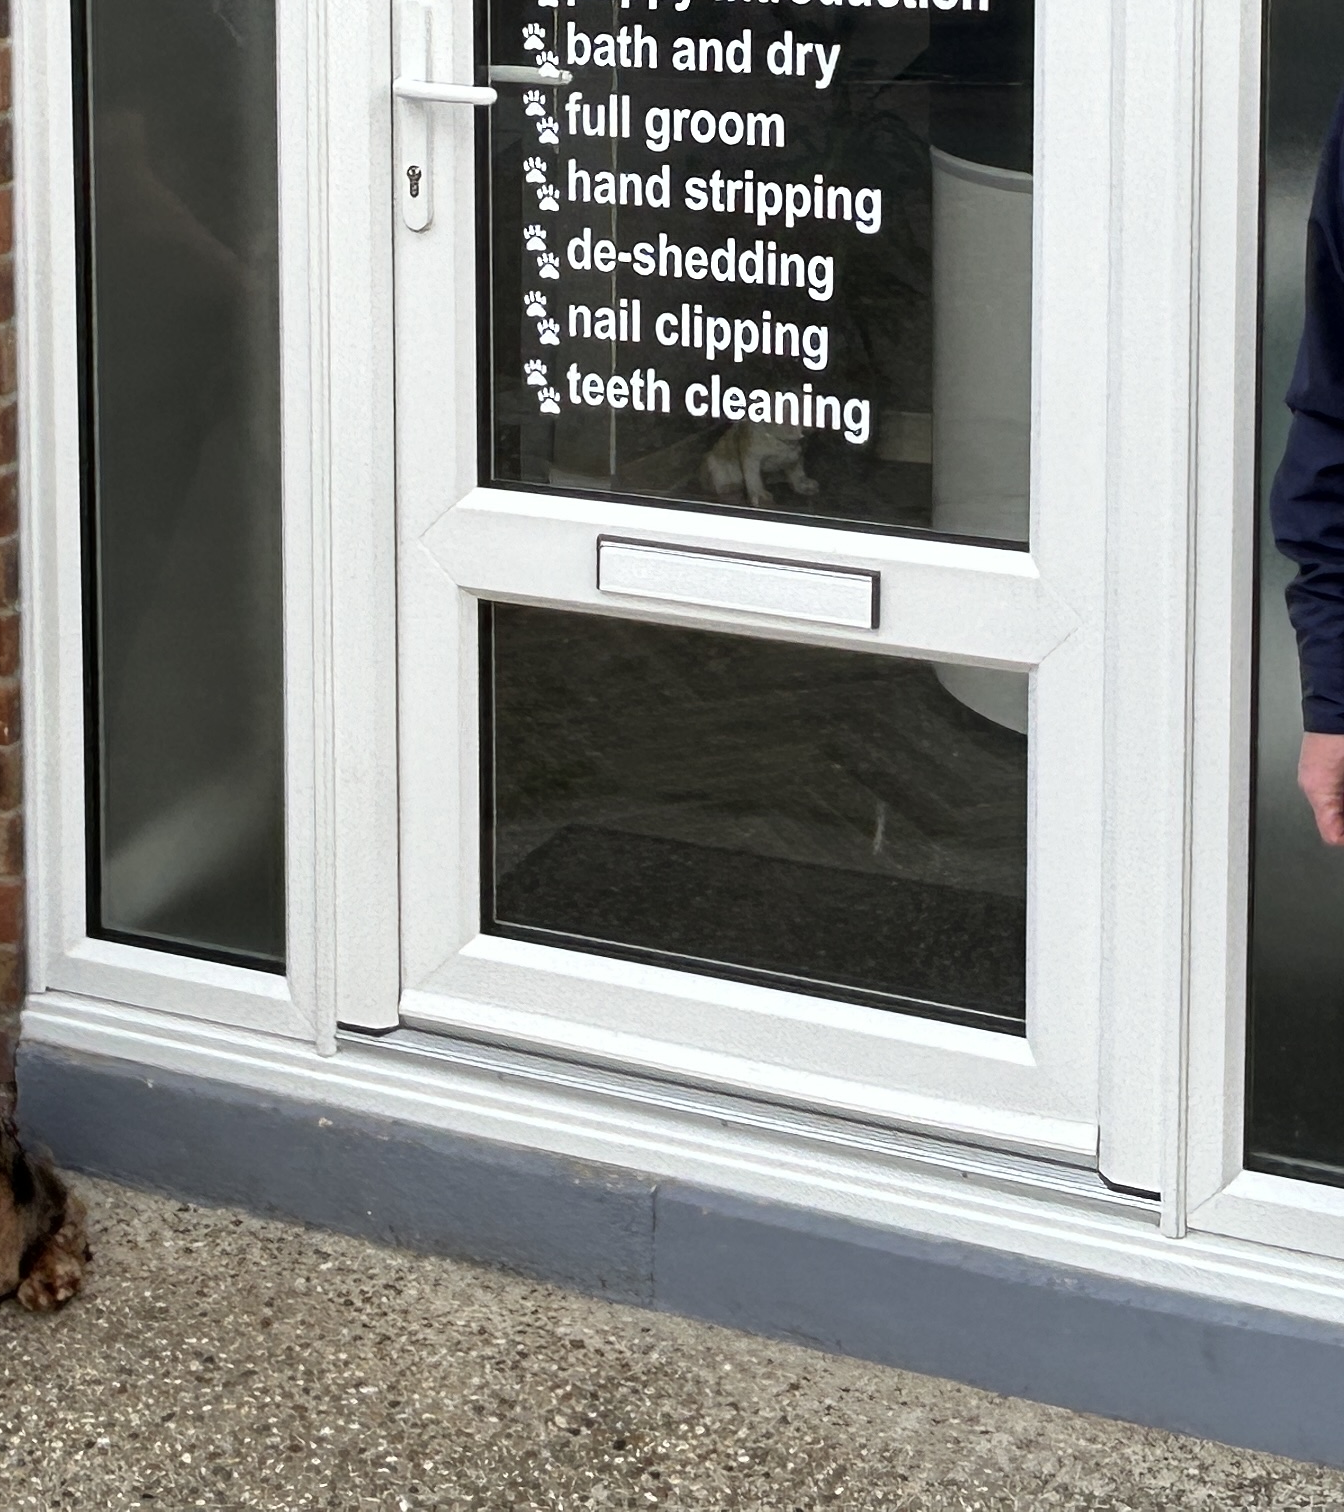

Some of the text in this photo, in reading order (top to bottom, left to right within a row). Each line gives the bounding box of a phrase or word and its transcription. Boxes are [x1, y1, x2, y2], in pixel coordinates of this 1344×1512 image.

[566, 21, 841, 89] bath and dry
[564, 91, 785, 152] full groom
[567, 158, 882, 234] hand stripping
[567, 227, 834, 302] de-shedding
[568, 298, 829, 371] nail clipping
[566, 362, 870, 444] teeth cleaning
